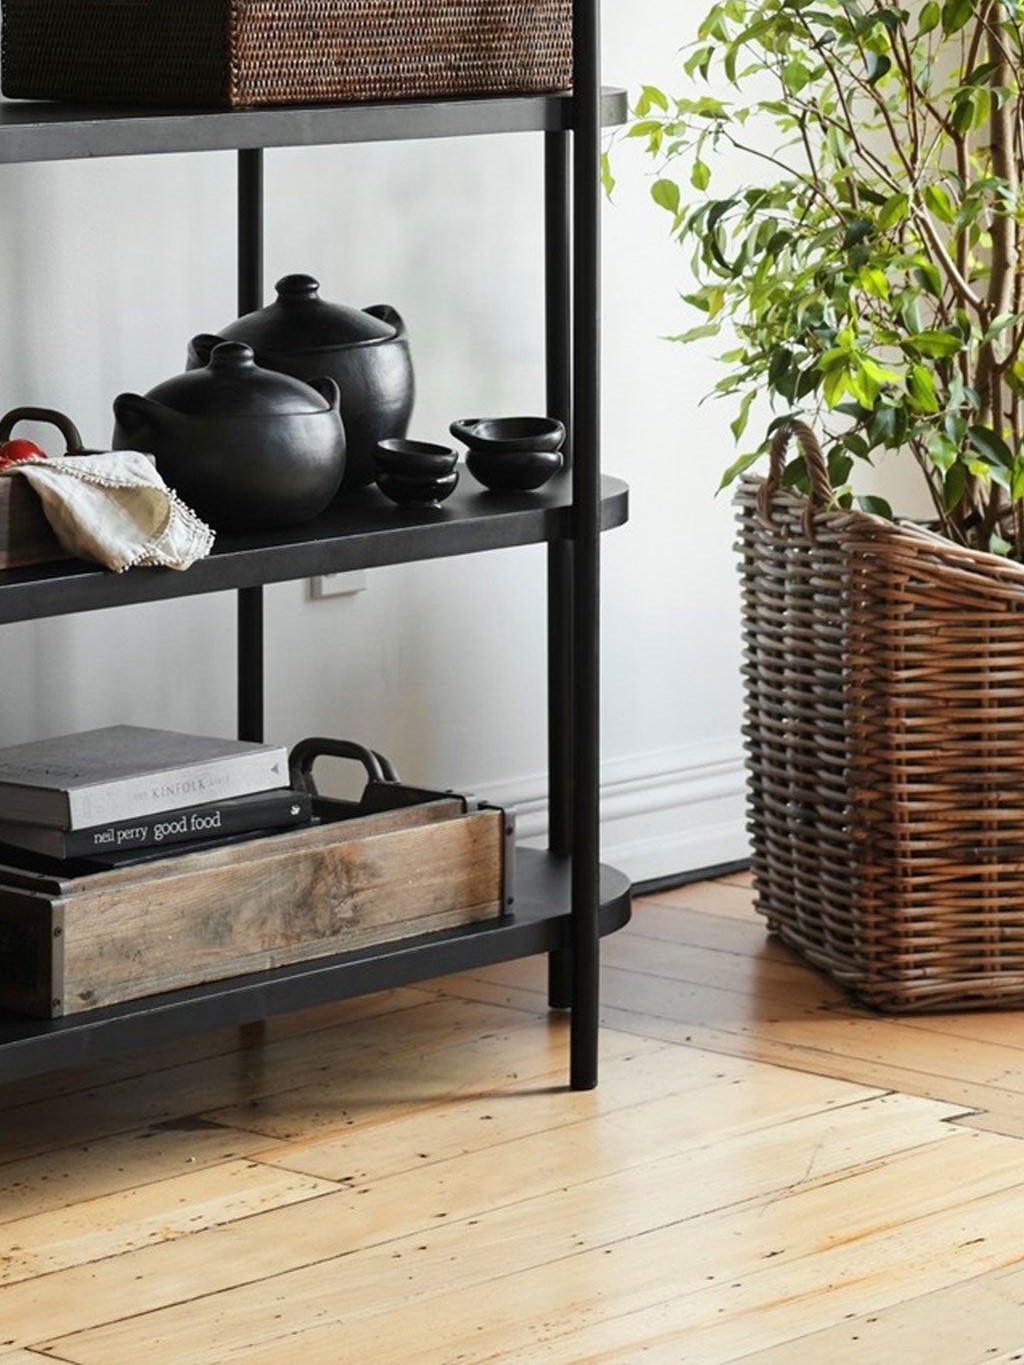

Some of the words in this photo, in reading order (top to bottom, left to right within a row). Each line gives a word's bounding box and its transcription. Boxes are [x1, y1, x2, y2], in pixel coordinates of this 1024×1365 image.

[152, 778, 207, 799] KINFOLK
[94, 828, 115, 844] neil
[117, 826, 148, 844] perry
[153, 816, 188, 841] good
[190, 811, 222, 831] food
